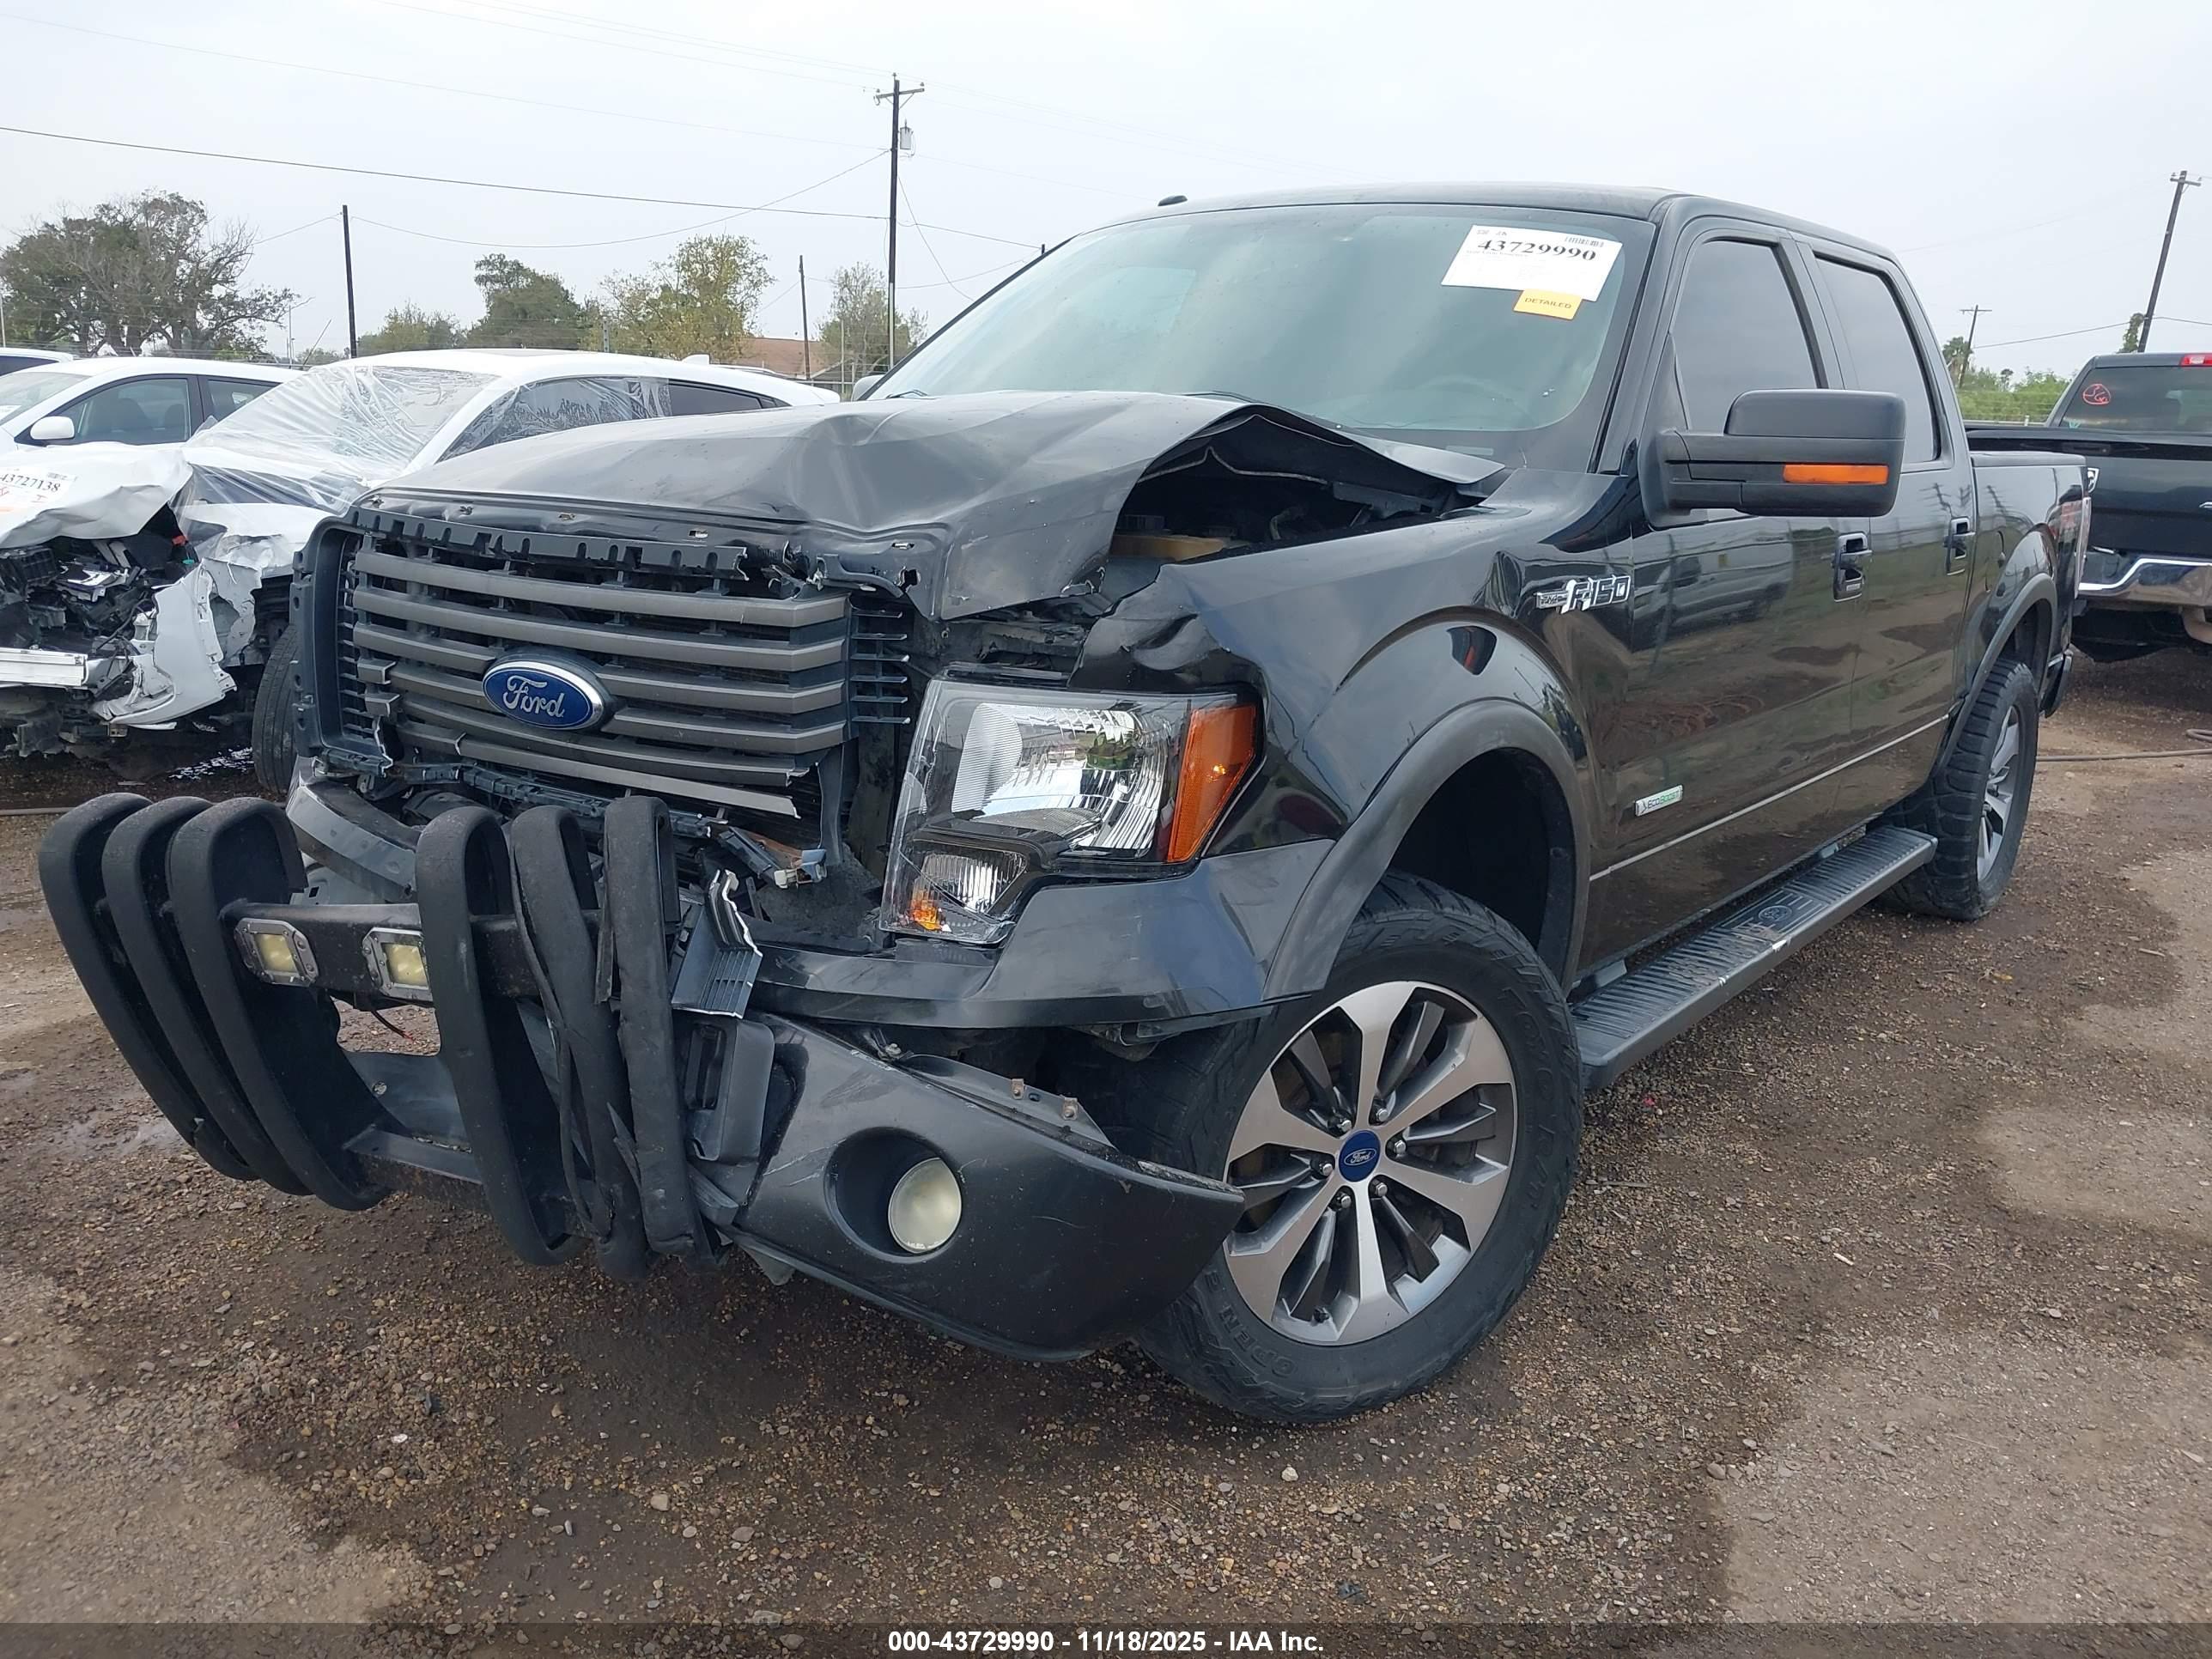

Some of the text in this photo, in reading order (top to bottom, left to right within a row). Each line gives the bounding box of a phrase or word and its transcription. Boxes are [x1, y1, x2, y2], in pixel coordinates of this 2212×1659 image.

[1477, 240, 1596, 261] 43729990
[1524, 297, 1571, 309] DETAILED
[0, 473, 61, 493] 43727138
[502, 675, 566, 718] Ford
[1350, 1151, 1372, 1164] Ford
